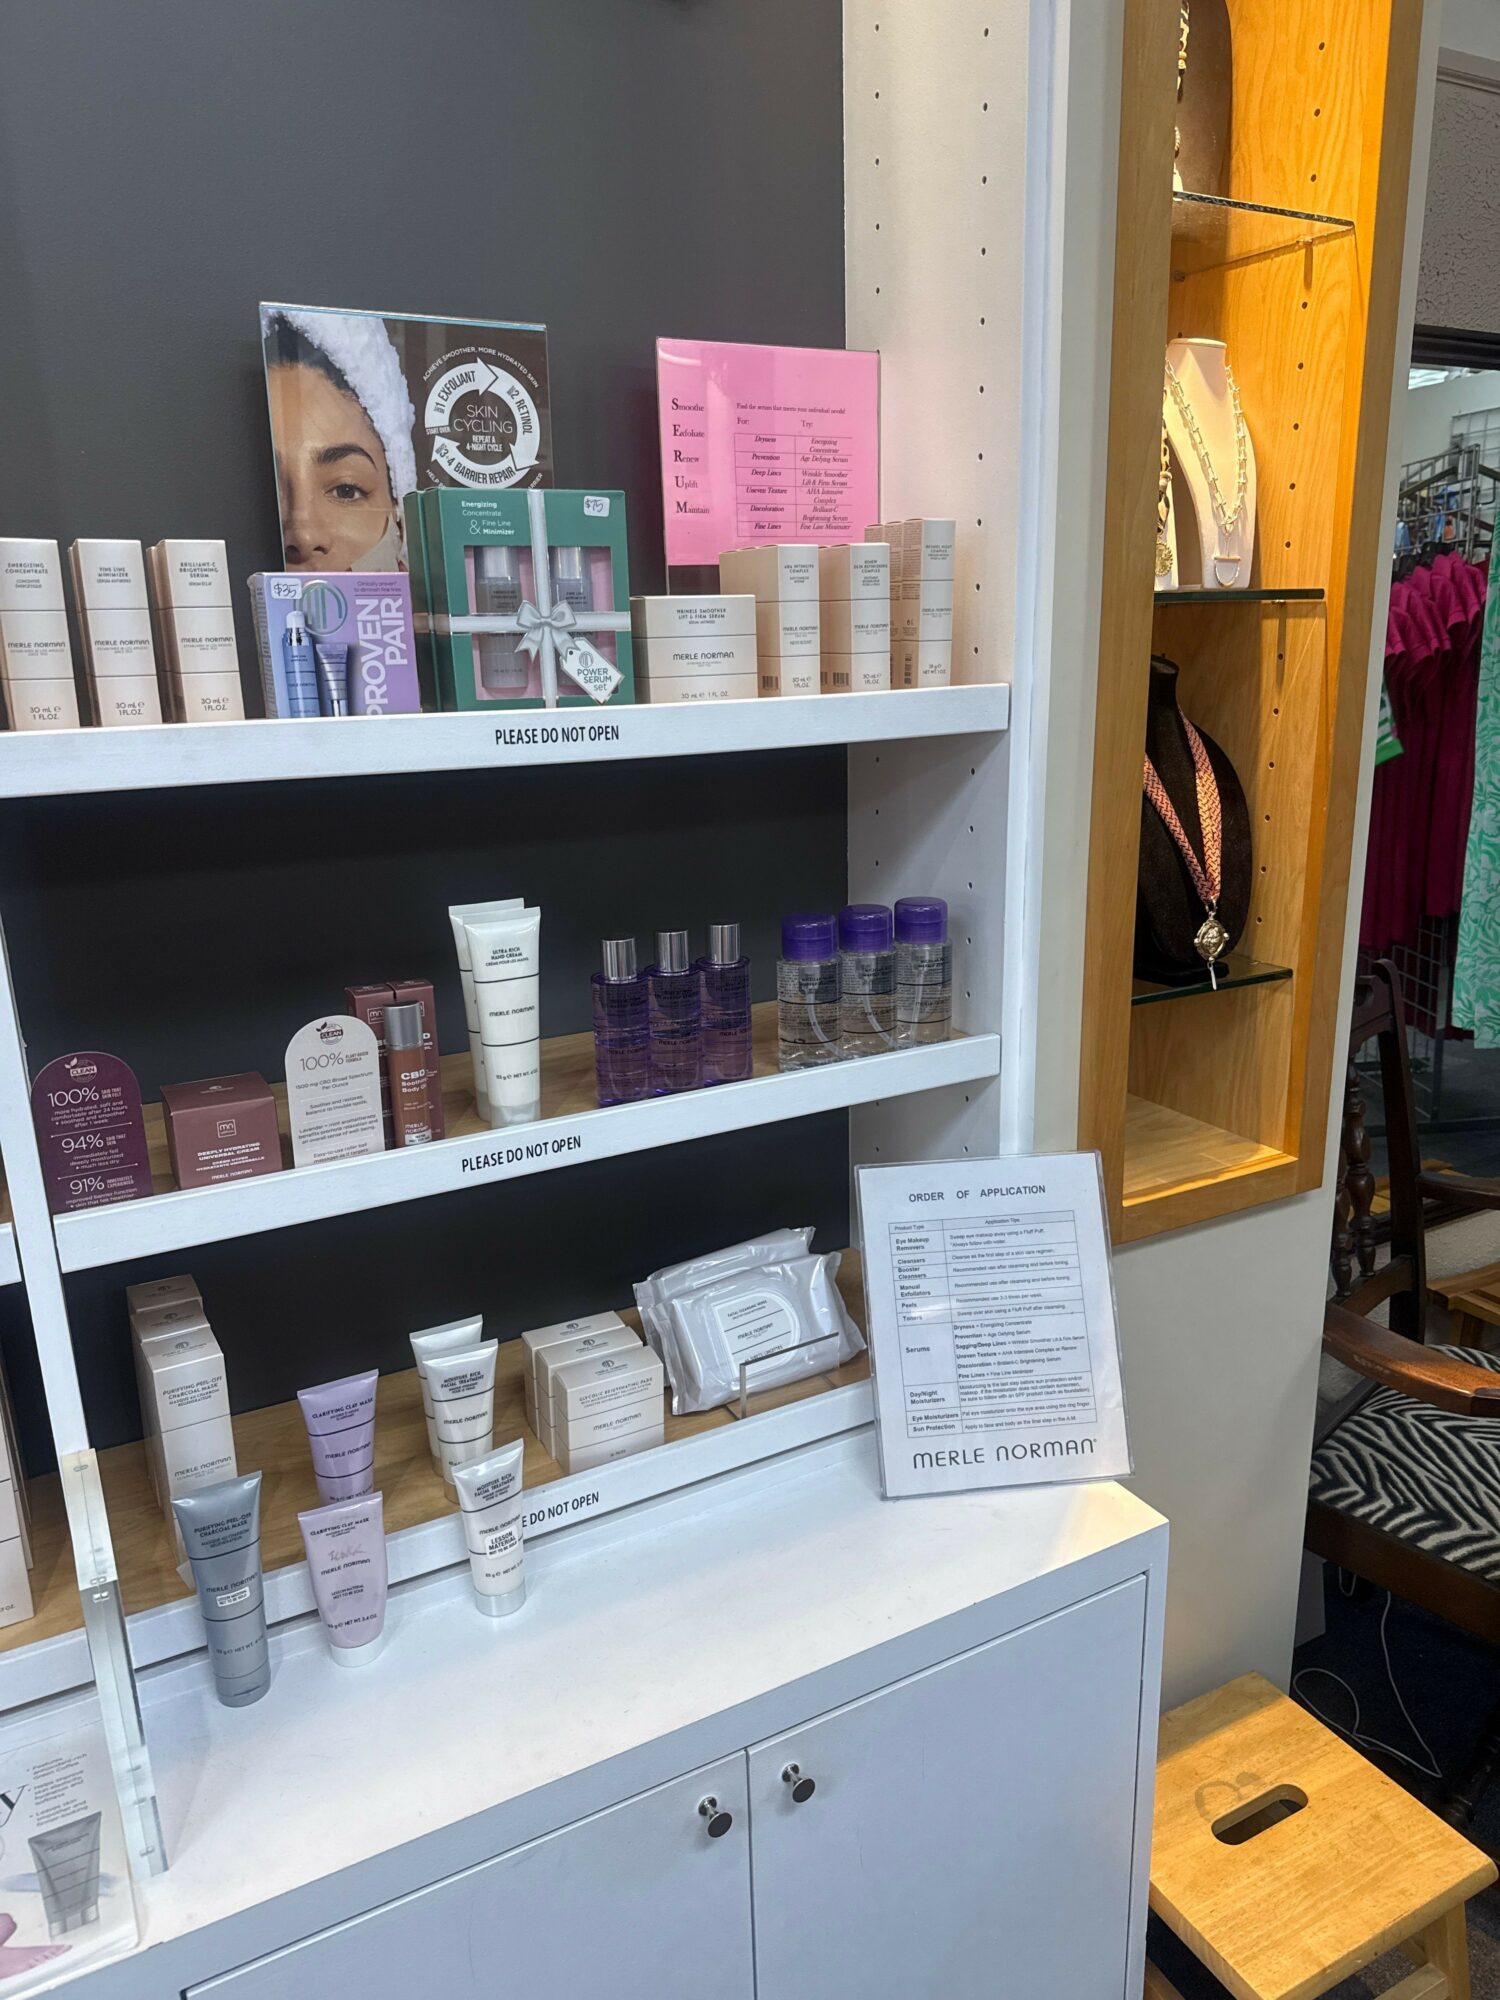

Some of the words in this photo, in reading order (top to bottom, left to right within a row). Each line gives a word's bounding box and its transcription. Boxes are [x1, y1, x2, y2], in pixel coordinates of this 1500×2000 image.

[422, 358, 443, 382] ACHIEVE
[478, 347, 497, 355] MORE
[498, 352, 528, 375] HYDRATED
[528, 373, 539, 389] SKIN
[438, 371, 476, 401] EXFOLIANT
[466, 405, 498, 418] SKIN
[672, 398, 704, 412] Smoothe
[515, 399, 533, 435] RETINOL
[453, 419, 513, 433] CYCLING
[673, 424, 705, 437] Exfoliate
[472, 435, 490, 443] REPEAT
[466, 443, 487, 452] 4-NIGHT
[488, 444, 503, 452] CYCLE
[674, 450, 699, 462] Renew
[454, 463, 488, 484] BARRIER
[489, 466, 516, 485] REPAIR
[675, 476, 698, 490] Uplift
[461, 501, 497, 509] Energizing
[585, 499, 604, 513] $75
[676, 501, 710, 514] Maintain
[470, 520, 480, 535] &
[274, 583, 299, 598] $35
[380, 598, 408, 665] PAIR
[673, 653, 698, 661] MERLE
[701, 651, 734, 659] NORMAN
[577, 668, 609, 676] POWER
[594, 683, 607, 692] set
[495, 728, 538, 745] PLEASE
[542, 728, 559, 744] DO
[562, 726, 586, 742] NOT
[588, 725, 620, 741] OPEN
[512, 1005, 535, 1015] NORMAN
[321, 1030, 343, 1039] CLEAN
[300, 1051, 344, 1072] 100%
[71, 1067, 96, 1076] CLEAN
[401, 1069, 426, 1080] CBD
[48, 1086, 100, 1108] 100%
[62, 1133, 104, 1154] 94%
[224, 1142, 261, 1152] HYDRATING
[199, 1152, 235, 1161] UNIVERSAL
[462, 1151, 504, 1173] PLEASE
[507, 1148, 523, 1164] DO
[526, 1141, 549, 1159] NOT
[552, 1135, 582, 1154] OPEN
[70, 1176, 105, 1195] 91%
[908, 1191, 945, 1203] ORDER
[956, 1190, 970, 1199] OF
[980, 1185, 1046, 1198] APPLICATION
[907, 1237, 930, 1245] Makeup
[897, 1257, 926, 1265] Cleansers
[897, 1266, 920, 1274] Booster
[898, 1272, 927, 1280] Cleansers
[900, 1290, 931, 1298] Exfoliators
[954, 1323, 975, 1332] Dryness
[954, 1332, 983, 1341] Prevention
[905, 1345, 931, 1354] Serums
[956, 1341, 992, 1351] Sagging/Deep
[956, 1352, 976, 1360] Uneven
[957, 1362, 992, 1370] Discoloration
[441, 1381, 457, 1389] FACIAL
[458, 1375, 485, 1385] TREATMENT
[444, 1374, 468, 1383] MOISTURE
[163, 1384, 195, 1396] PURIFYING
[196, 1376, 222, 1387] PEEL-OFF
[169, 1388, 201, 1400] CHARCOAL
[202, 1383, 218, 1392] MASK
[909, 1390, 938, 1398] Day/Night
[910, 1396, 946, 1406] Moisturizers
[312, 1407, 344, 1419] CLARIFYING
[346, 1402, 358, 1410] CLAY
[360, 1398, 374, 1406] MASK
[464, 1411, 488, 1422] NORMAN
[593, 1422, 613, 1431] MERLE
[615, 1413, 642, 1425] NORMAN
[924, 1412, 959, 1422] Moisturizers
[924, 1423, 956, 1431] Protection
[325, 1451, 346, 1460] MERLE
[348, 1441, 371, 1455] NORMAN
[913, 1448, 985, 1469] MERLE
[996, 1438, 1094, 1462] NORMAN
[175, 1466, 198, 1477] MERLE
[201, 1456, 232, 1469] NORMAN
[474, 1488, 490, 1497] FACIAL
[491, 1476, 516, 1491] TREATMENT
[477, 1478, 500, 1492] MOISTURE
[501, 1473, 512, 1481] RICH
[530, 1510, 545, 1525] DO
[548, 1502, 570, 1520] NOT
[571, 1492, 599, 1510] OPEN
[194, 1520, 225, 1534] PURIFYING
[226, 1512, 252, 1525] PEEL-OFF
[200, 1525, 231, 1538] CHARCOAL
[231, 1520, 248, 1529] MASK
[310, 1524, 341, 1537] CLARIFYING
[355, 1517, 369, 1525] MASK
[488, 1536, 517, 1551] MATERIAL
[491, 1531, 513, 1544] LESSON
[321, 1566, 341, 1576] MERLE
[343, 1558, 371, 1569] NORMAN
[206, 1585, 229, 1593] MERLE
[231, 1572, 259, 1590] NORMAN
